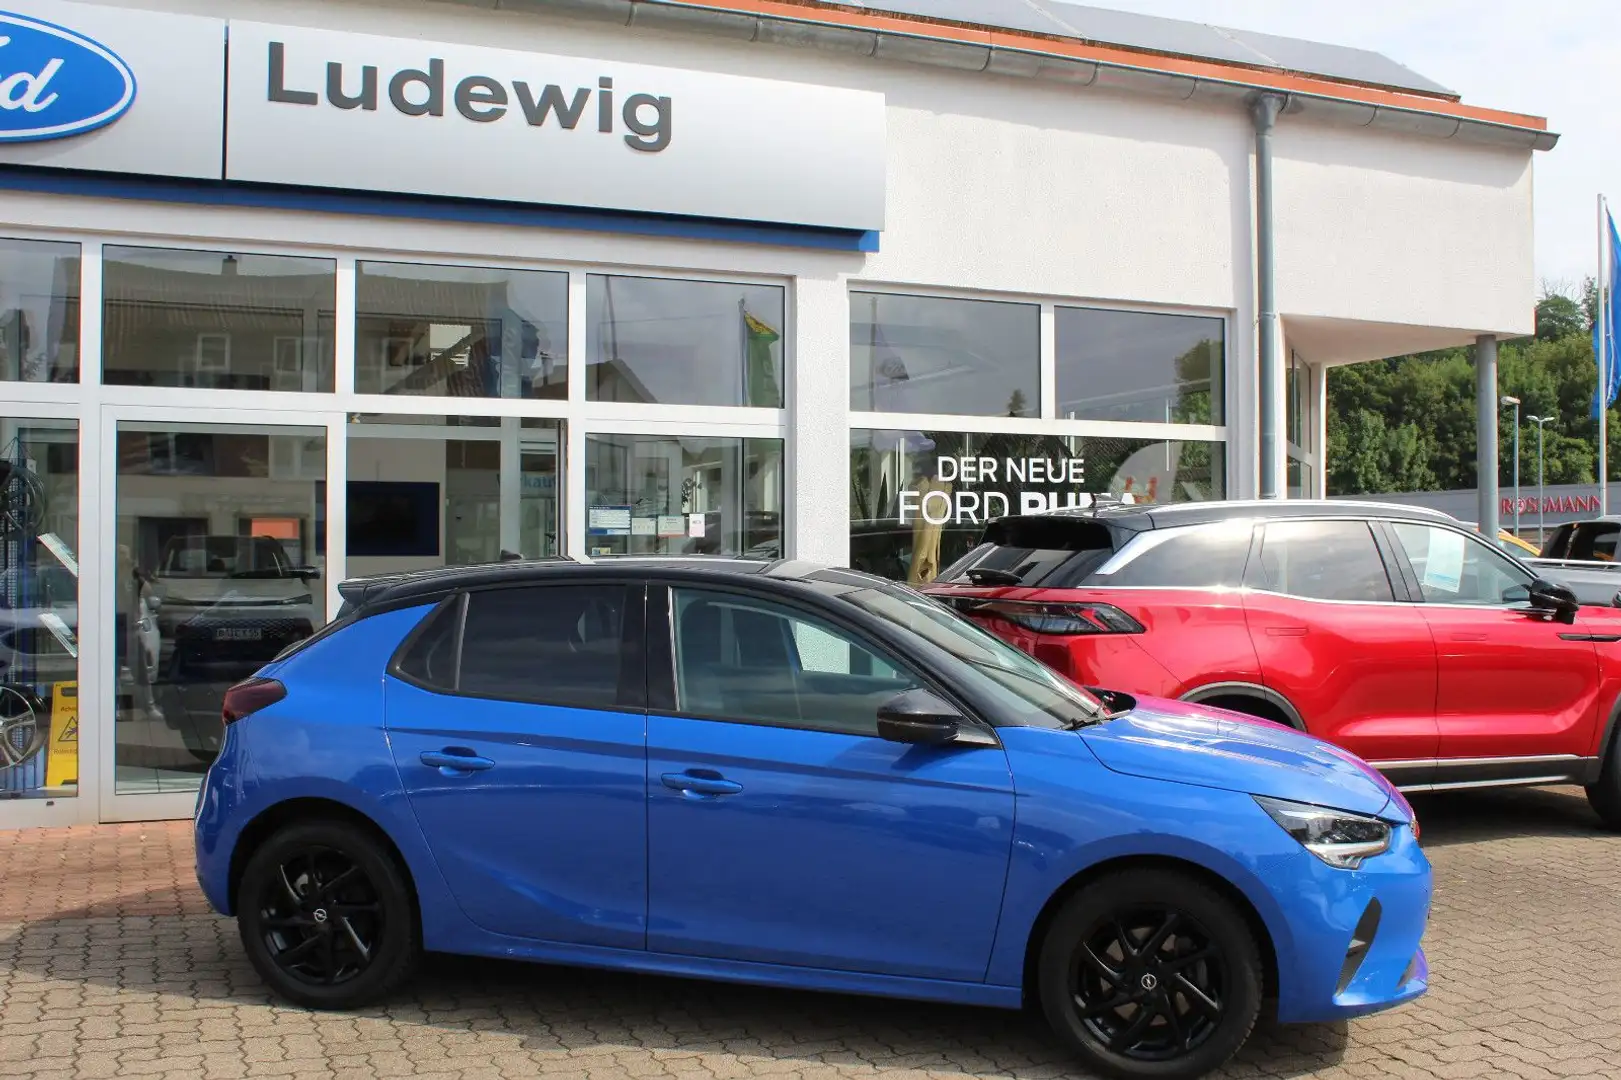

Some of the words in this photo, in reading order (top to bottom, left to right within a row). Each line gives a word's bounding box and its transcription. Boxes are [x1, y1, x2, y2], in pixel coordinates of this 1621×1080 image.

[268, 41, 672, 152] Ludewig
[937, 456, 998, 482] DER
[1006, 458, 1085, 483] NEUE
[899, 490, 1009, 525] FORD
[1501, 495, 1602, 515] ROSSMANN
